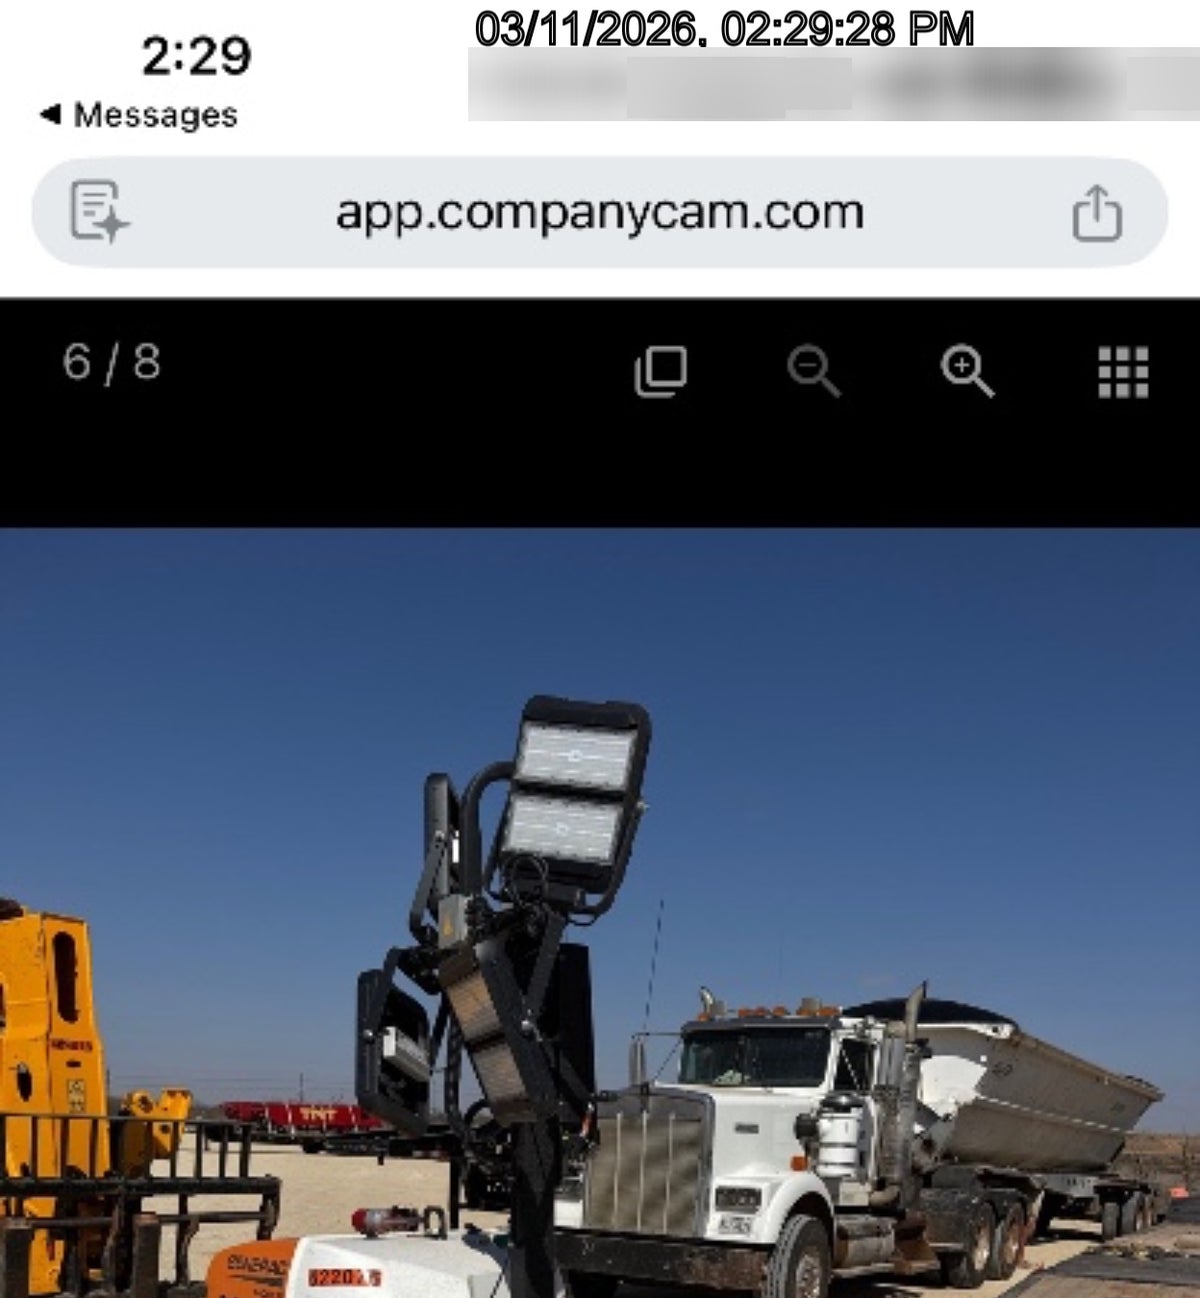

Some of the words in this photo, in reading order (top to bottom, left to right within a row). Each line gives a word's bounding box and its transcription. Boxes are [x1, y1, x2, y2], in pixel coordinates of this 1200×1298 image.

[143, 35, 252, 76] 2:29
[75, 101, 238, 134] Messages
[336, 198, 864, 240] app.companycam.com
[63, 342, 91, 380] 6
[103, 341, 120, 388] /
[134, 342, 160, 380] 8
[300, 1106, 338, 1121] TNT
